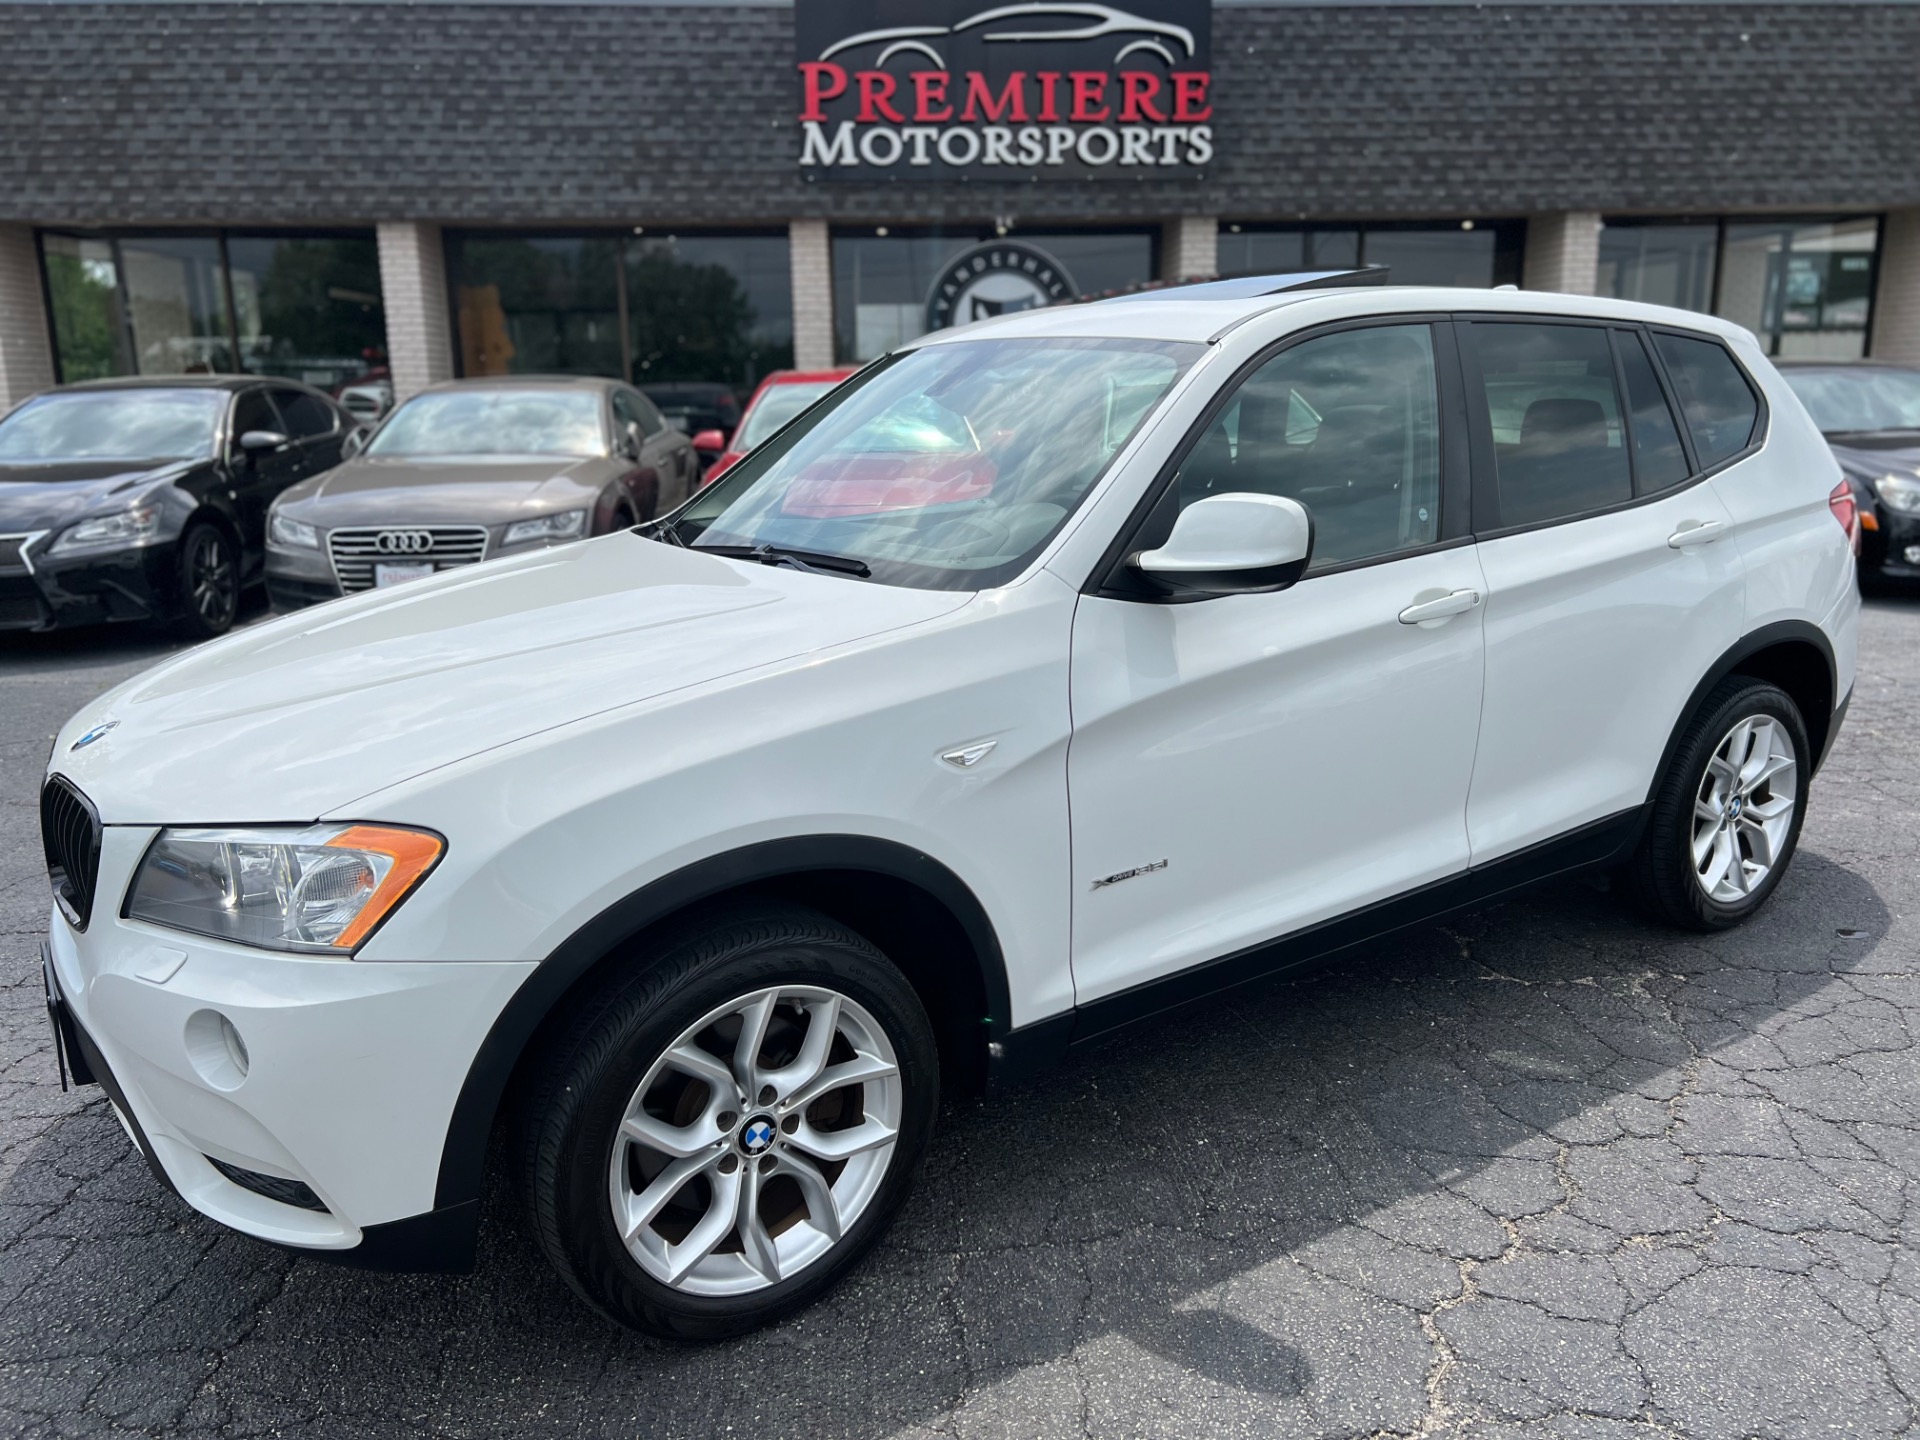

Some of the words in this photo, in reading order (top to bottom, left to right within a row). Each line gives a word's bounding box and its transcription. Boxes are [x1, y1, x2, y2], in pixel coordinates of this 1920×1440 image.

[798, 62, 1213, 122] PREMIERE
[799, 121, 1213, 166] MOTORSPORTS
[936, 251, 1064, 311] VANDERHAL
